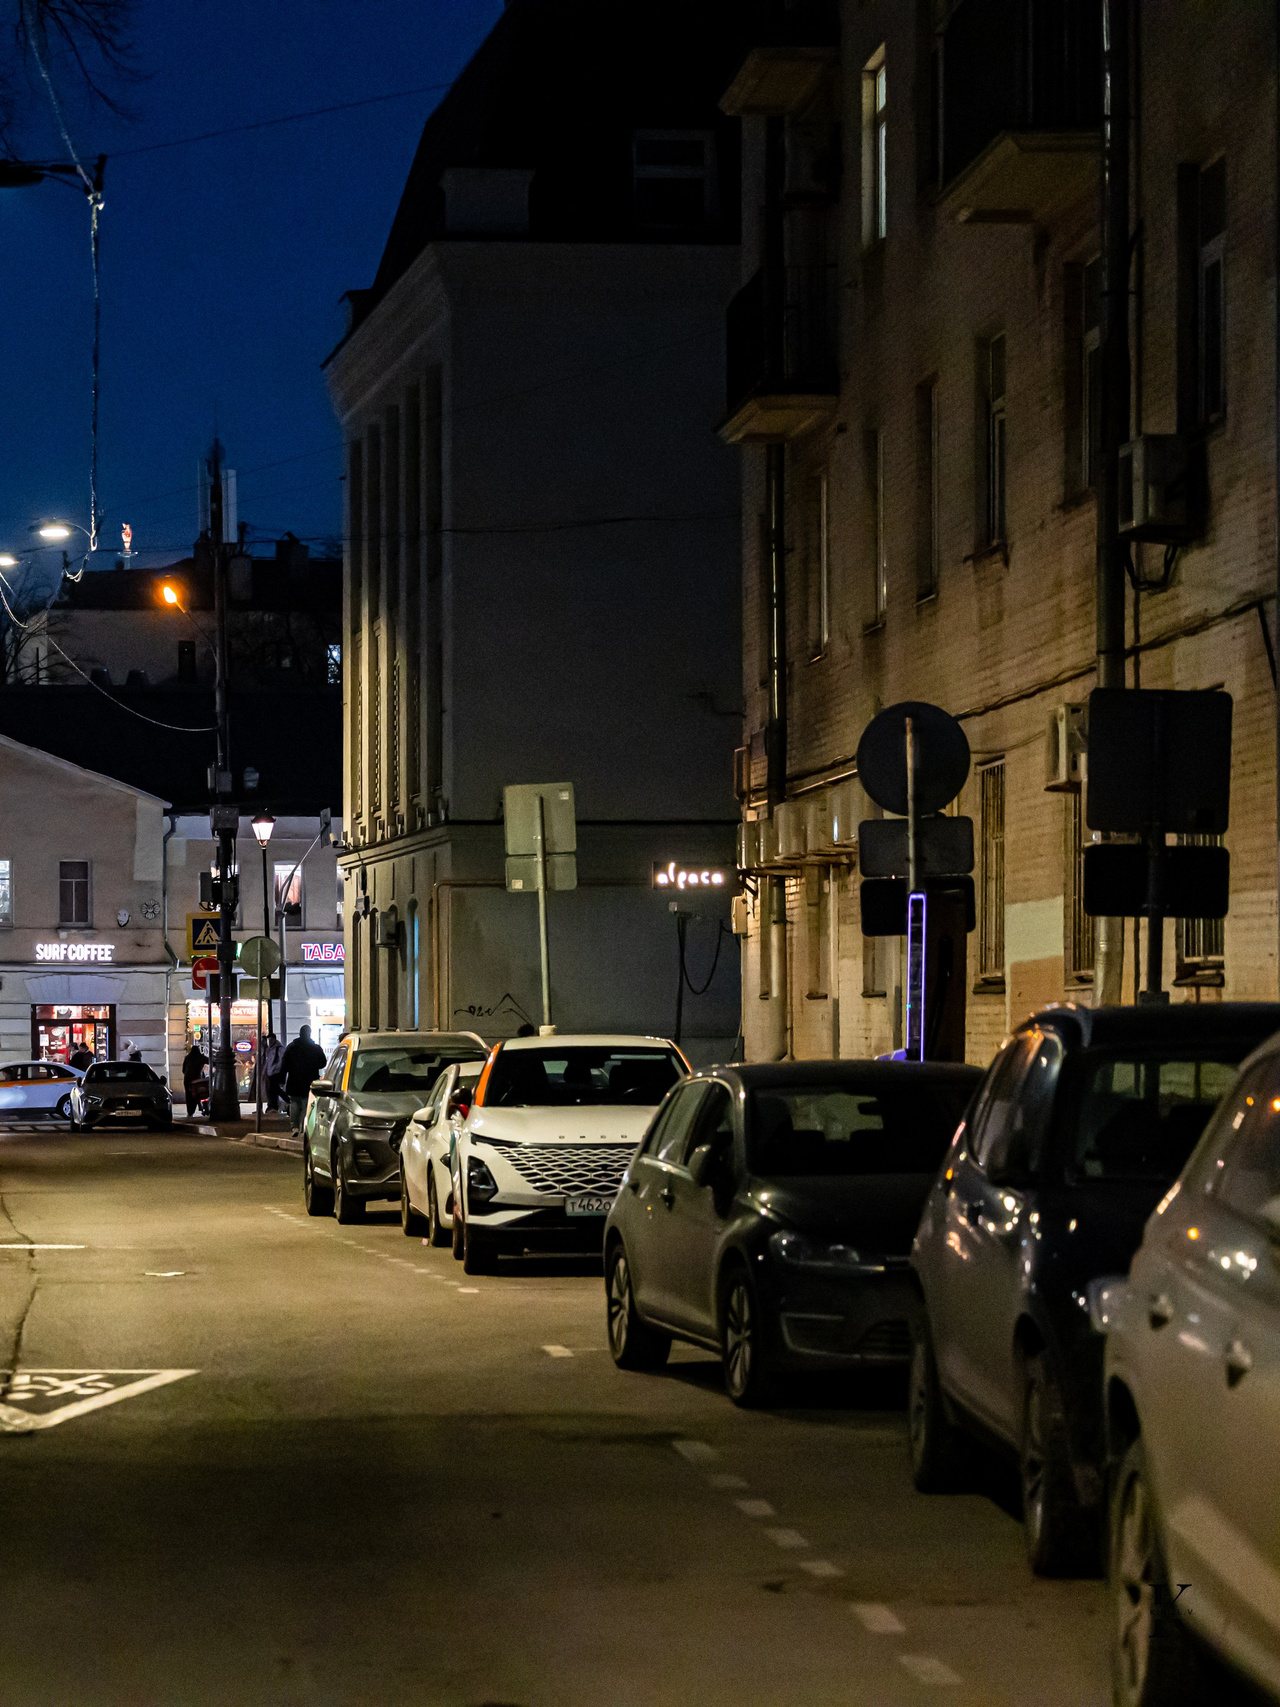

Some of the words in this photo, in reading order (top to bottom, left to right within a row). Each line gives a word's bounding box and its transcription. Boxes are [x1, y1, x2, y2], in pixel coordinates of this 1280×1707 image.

[657, 861, 723, 890] alpaca
[35, 943, 67, 961] SURF
[67, 944, 113, 961] COFFEE
